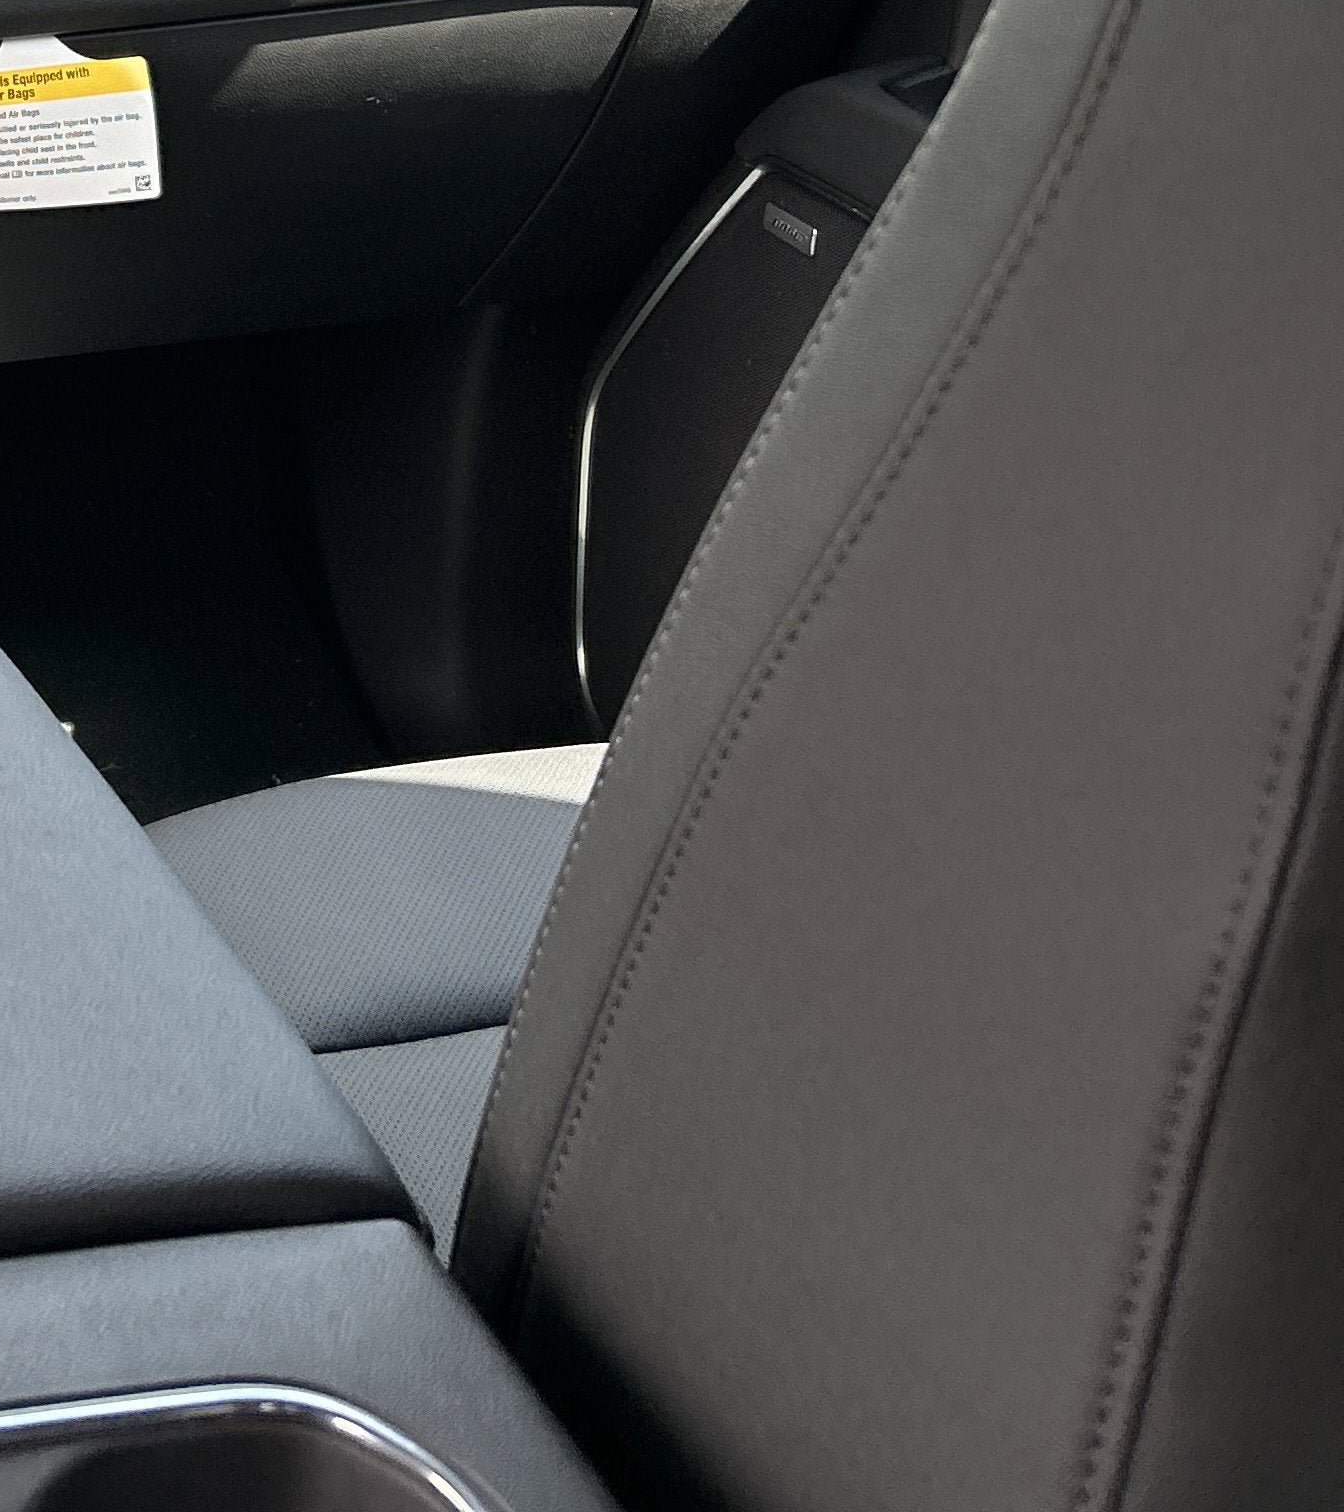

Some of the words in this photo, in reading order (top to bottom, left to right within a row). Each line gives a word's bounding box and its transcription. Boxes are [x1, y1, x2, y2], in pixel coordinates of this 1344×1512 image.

[12, 69, 63, 87] Equipped
[66, 67, 90, 80] with
[8, 88, 36, 100] Bags
